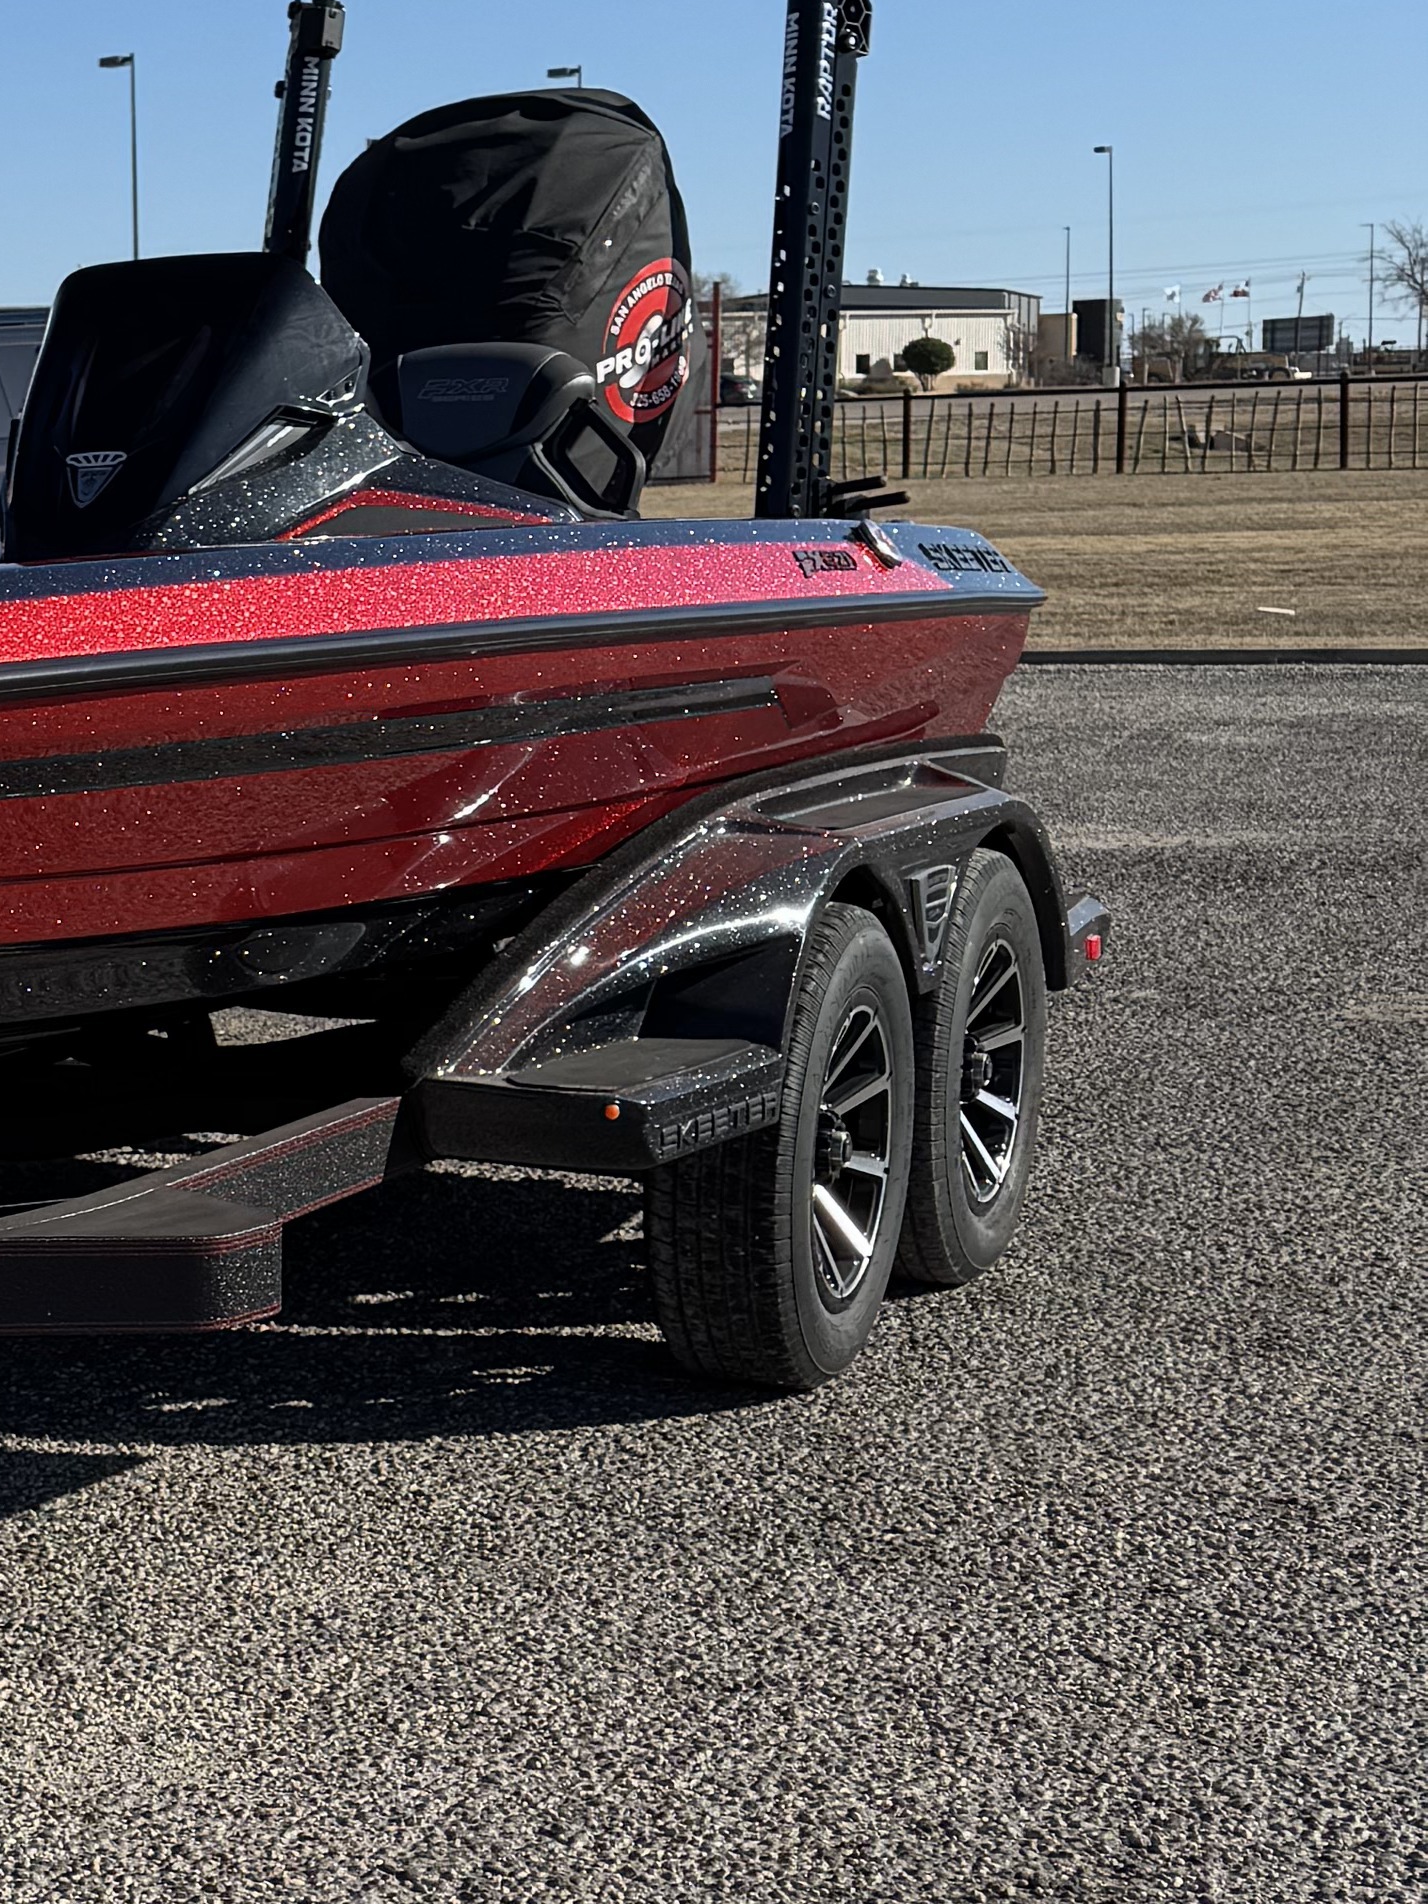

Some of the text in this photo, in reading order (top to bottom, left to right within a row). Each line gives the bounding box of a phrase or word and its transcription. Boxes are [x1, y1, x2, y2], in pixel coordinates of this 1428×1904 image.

[291, 56, 320, 173] MINN KOTA
[780, 11, 800, 138] MINN KOTA
[816, 1, 839, 120] RAPTOR
[610, 275, 665, 336] SAN ANGELO
[658, 1092, 779, 1154] SKEETER
